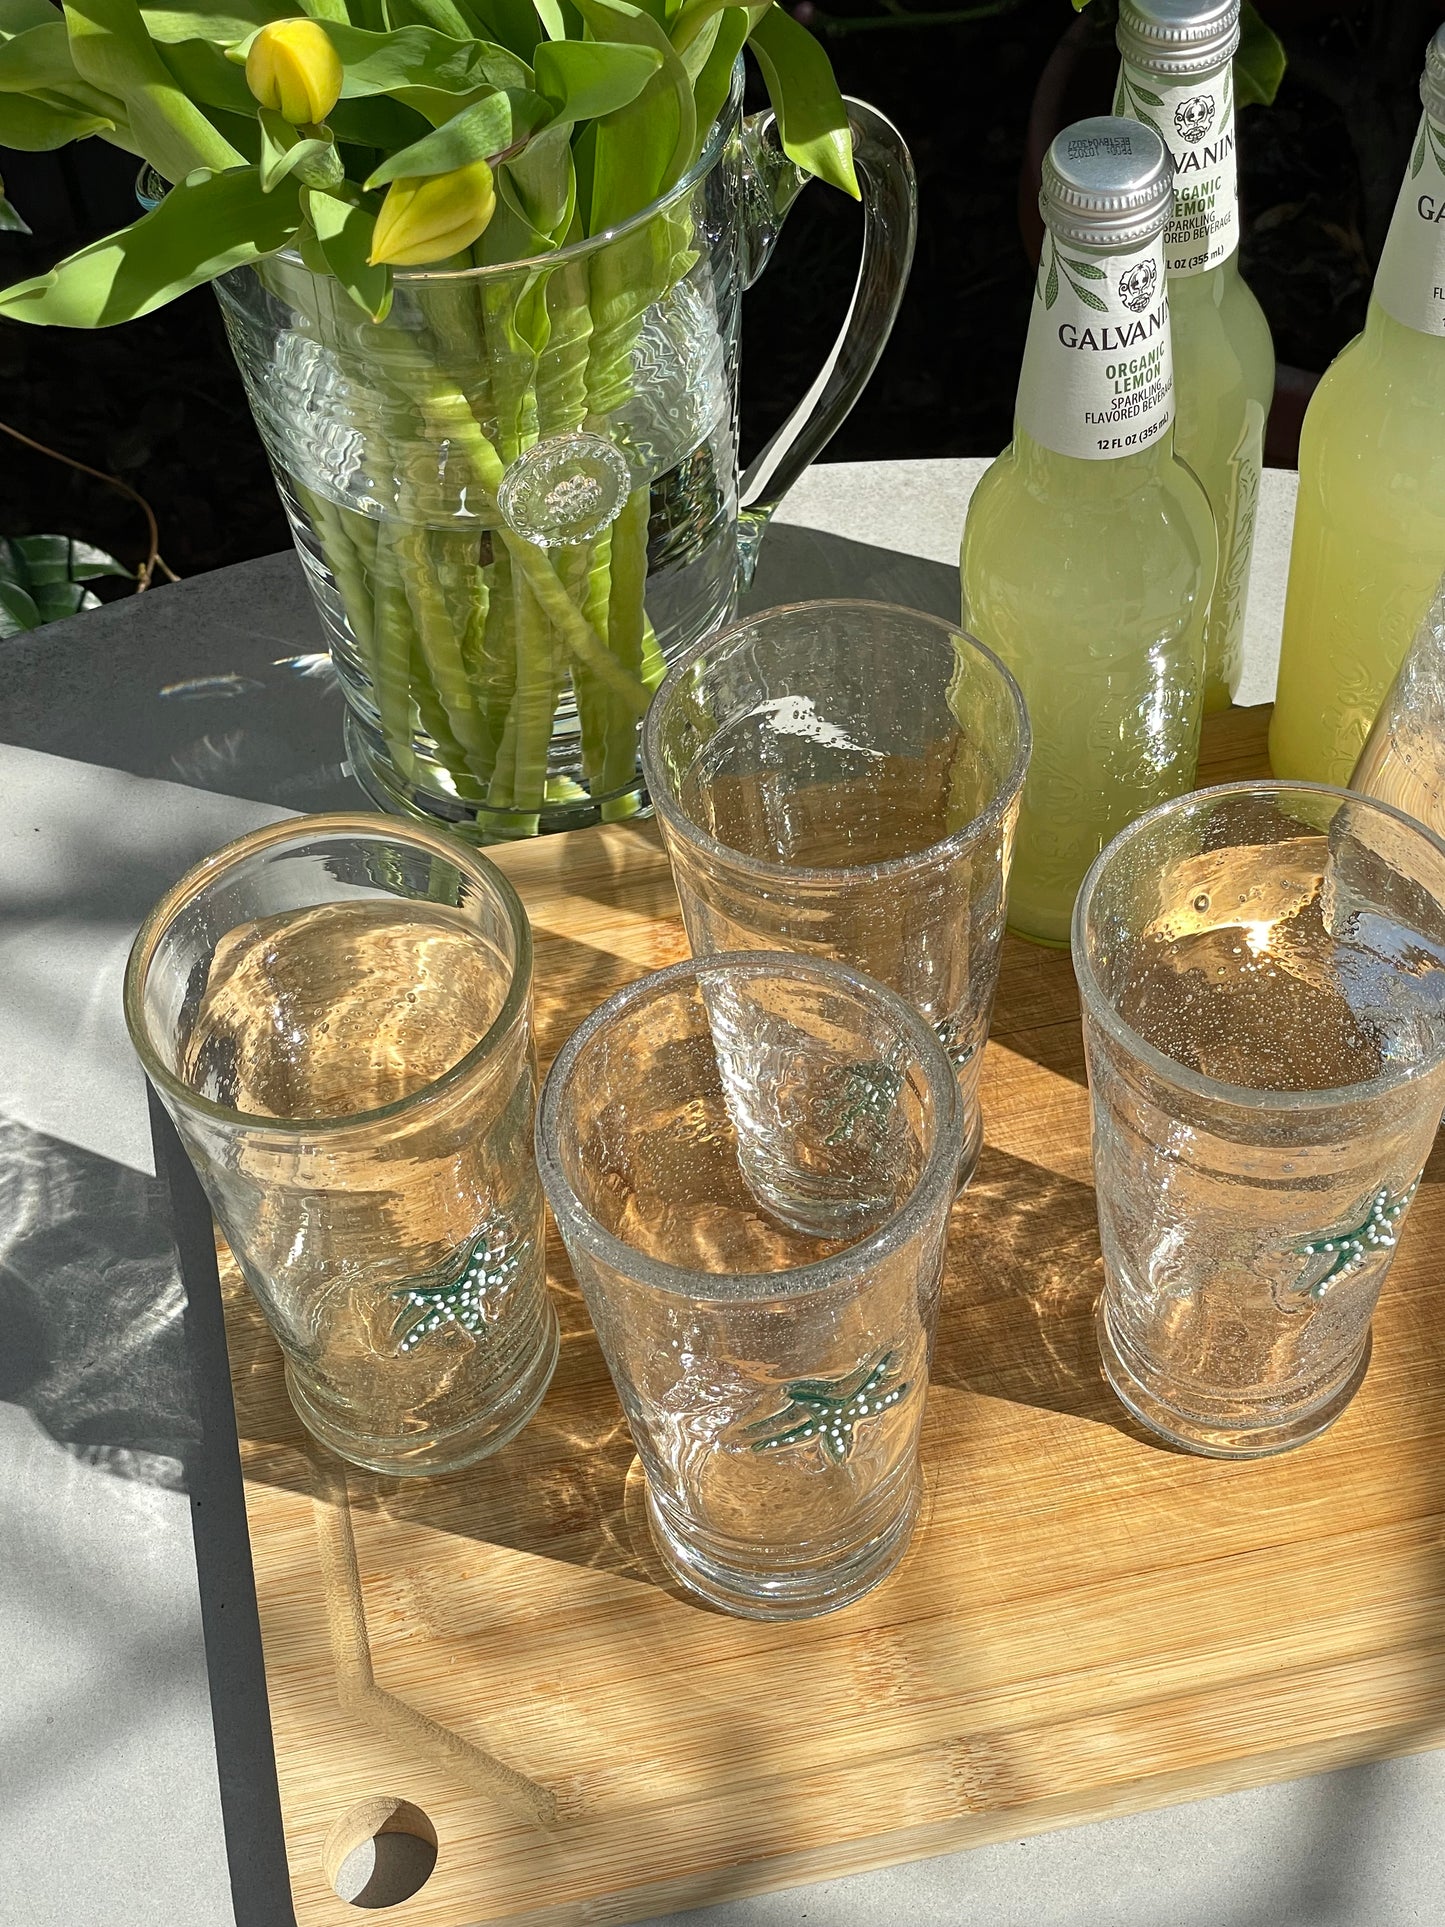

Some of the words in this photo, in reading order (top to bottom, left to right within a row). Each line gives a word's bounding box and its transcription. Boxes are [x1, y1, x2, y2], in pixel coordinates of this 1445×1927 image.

[1171, 194, 1215, 217] EMON
[1174, 259, 1186, 269] OZ
[1189, 252, 1209, 269] (355
[1105, 341, 1165, 379] ORGANIC
[1114, 361, 1161, 394] LEMON
[1111, 378, 1162, 410] SPARKLING
[1085, 404, 1140, 424] FLAVORED
[1097, 440, 1109, 449] 12
[1111, 438, 1122, 448] FL
[1125, 434, 1137, 446] OZ
[1139, 422, 1158, 443] (355
